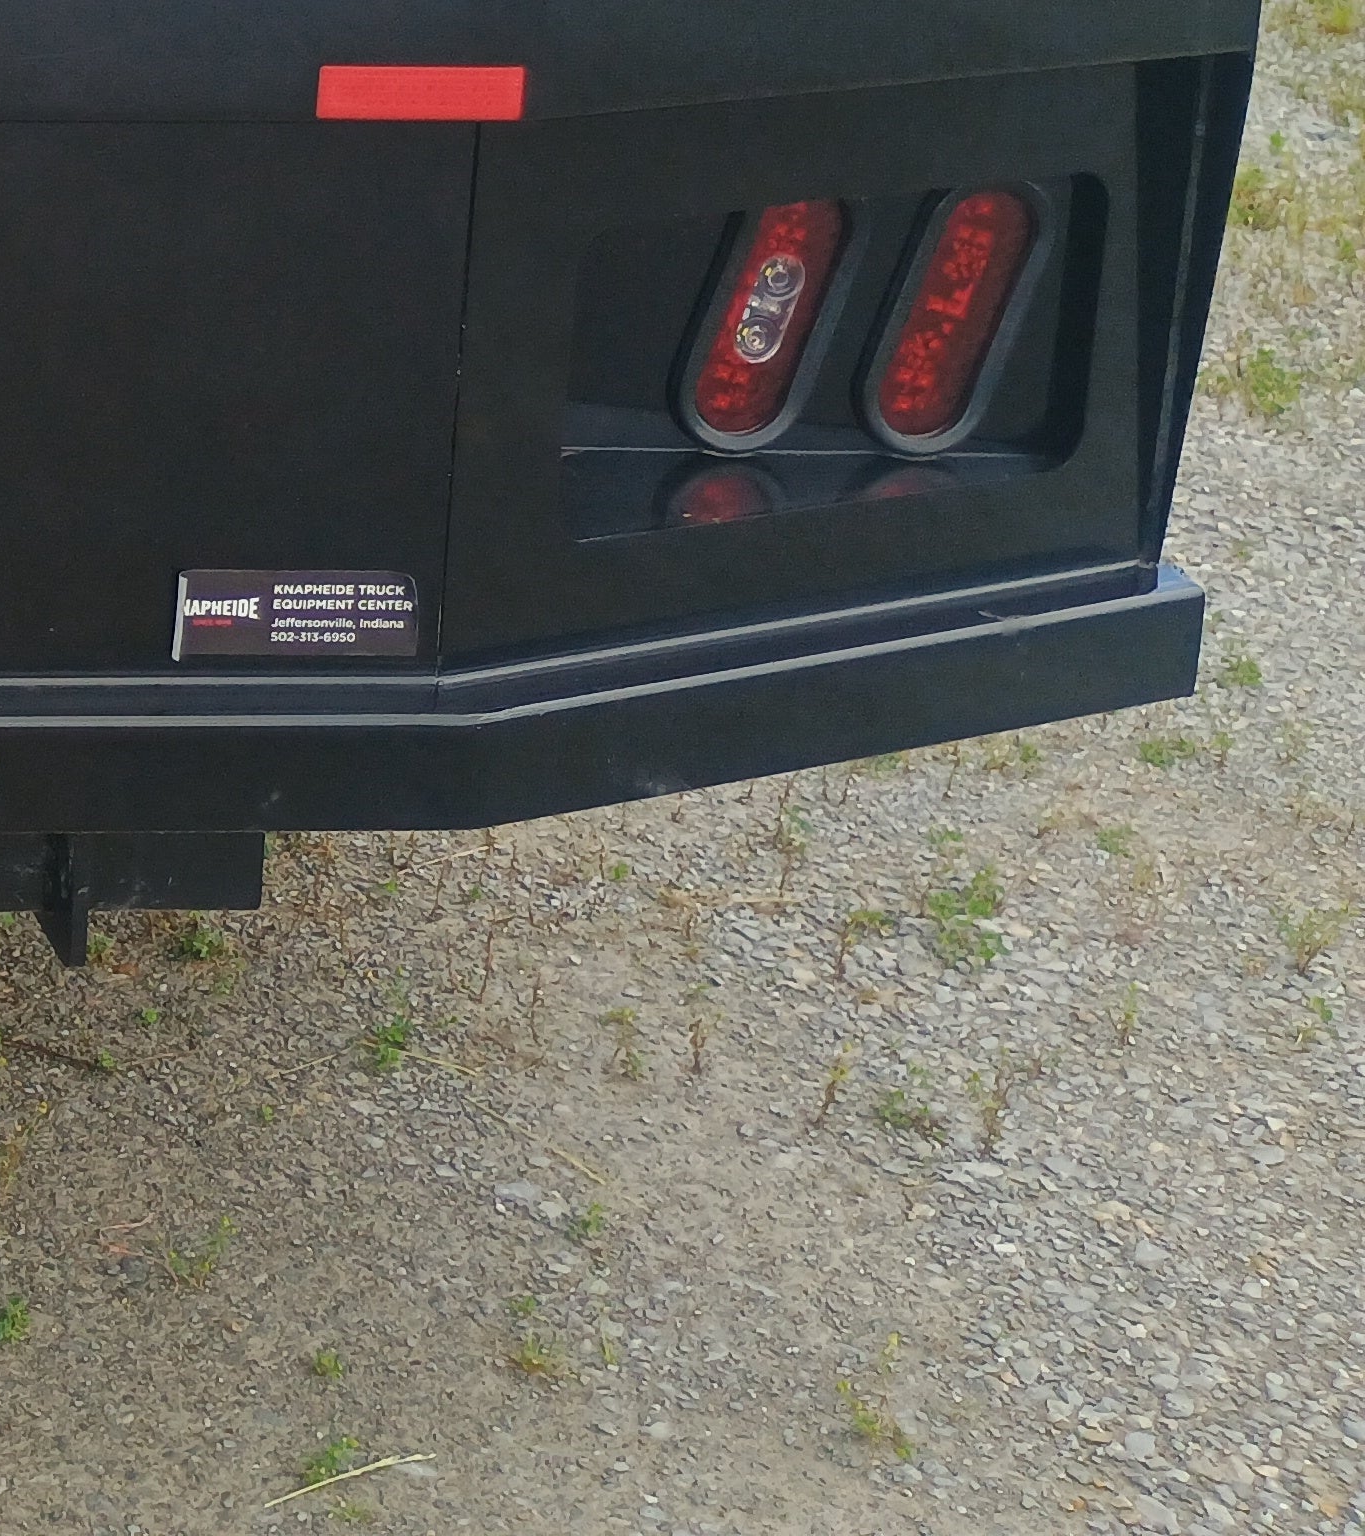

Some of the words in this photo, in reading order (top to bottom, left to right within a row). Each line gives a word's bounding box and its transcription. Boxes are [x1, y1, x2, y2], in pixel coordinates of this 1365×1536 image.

[273, 584, 355, 596] KNAPHEIDE
[358, 585, 405, 596] TRUCK
[272, 599, 355, 610] EQUIPMENT
[357, 600, 413, 612] CENTER
[271, 617, 356, 629] Jeffersonville,
[359, 618, 405, 629] Indiana
[270, 631, 356, 643] 502-313-6950
